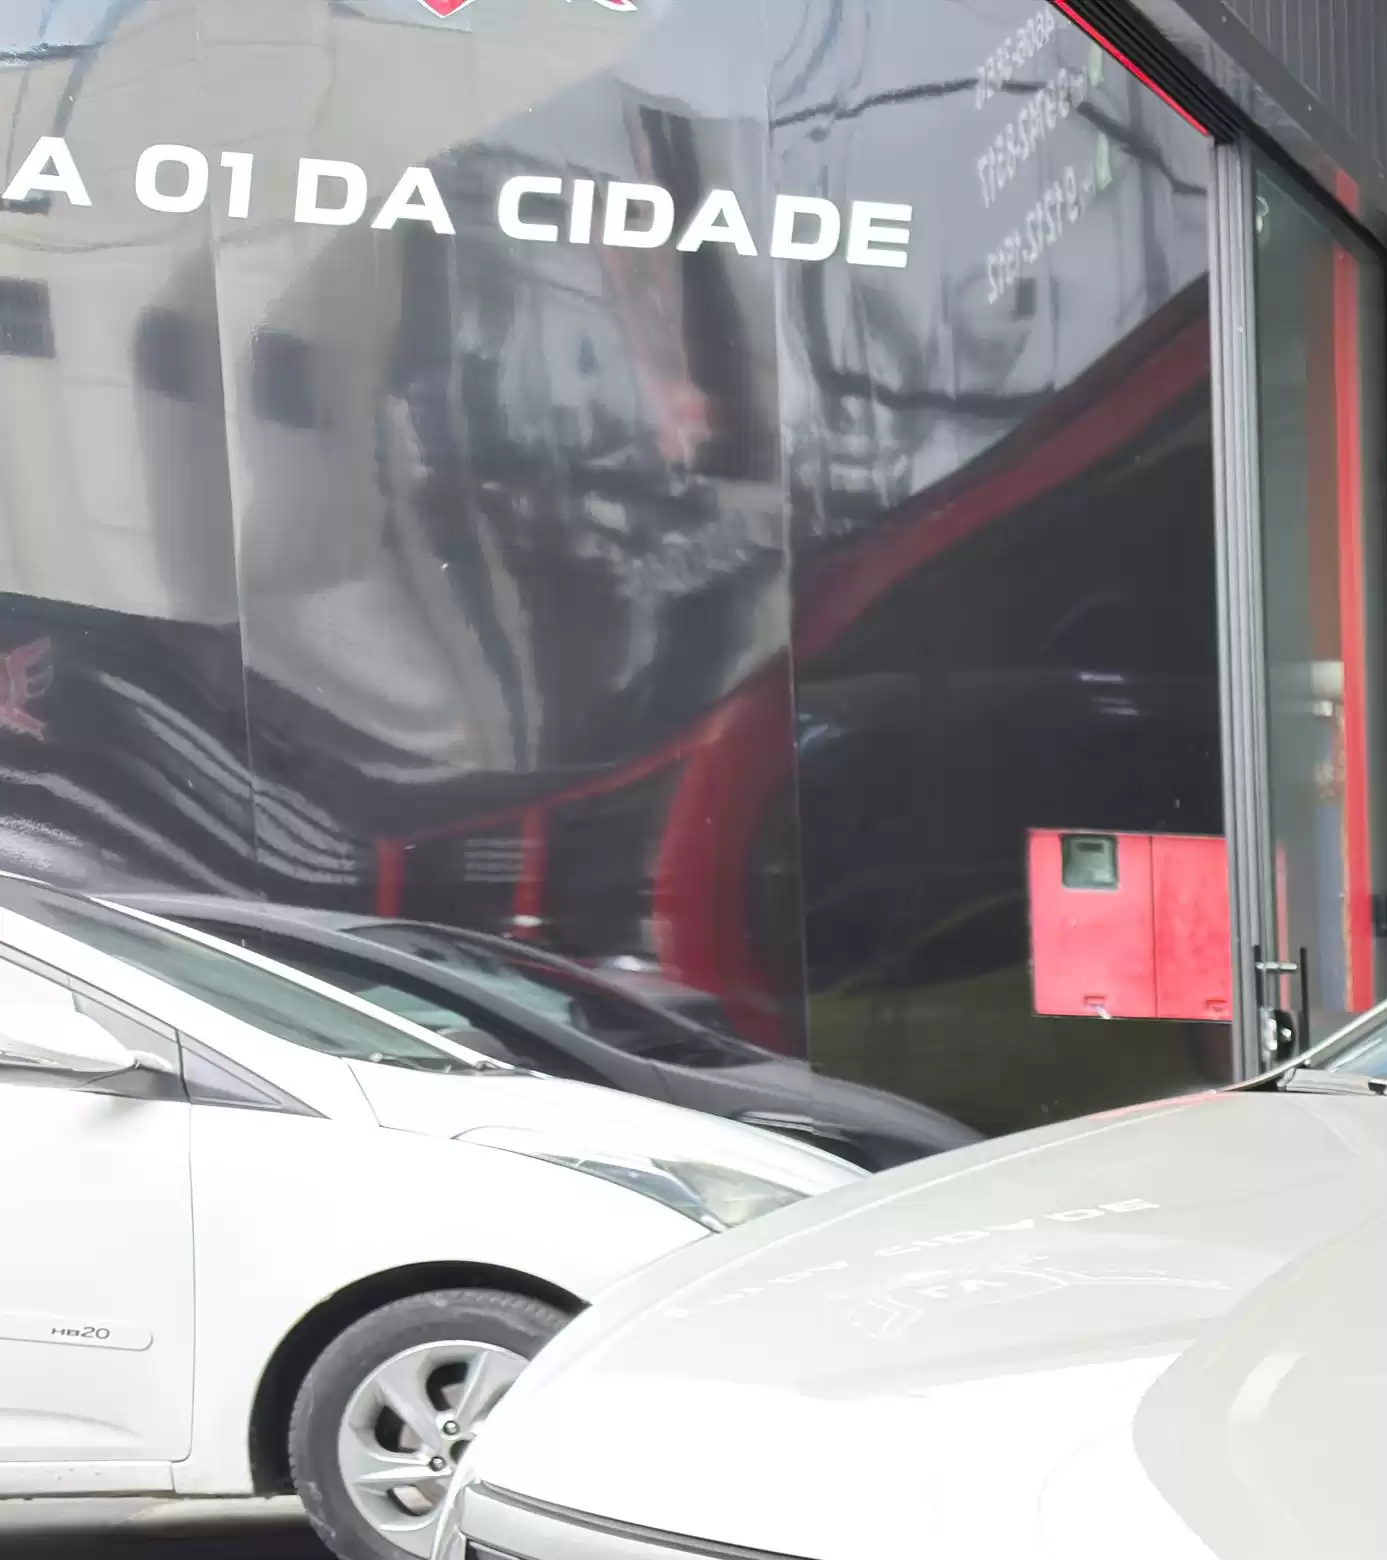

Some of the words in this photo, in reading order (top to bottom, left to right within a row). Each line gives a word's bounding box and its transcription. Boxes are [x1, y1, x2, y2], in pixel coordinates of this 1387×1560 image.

[1, 136, 93, 207] A
[295, 158, 456, 235] DA
[498, 176, 913, 268] CIDADE
